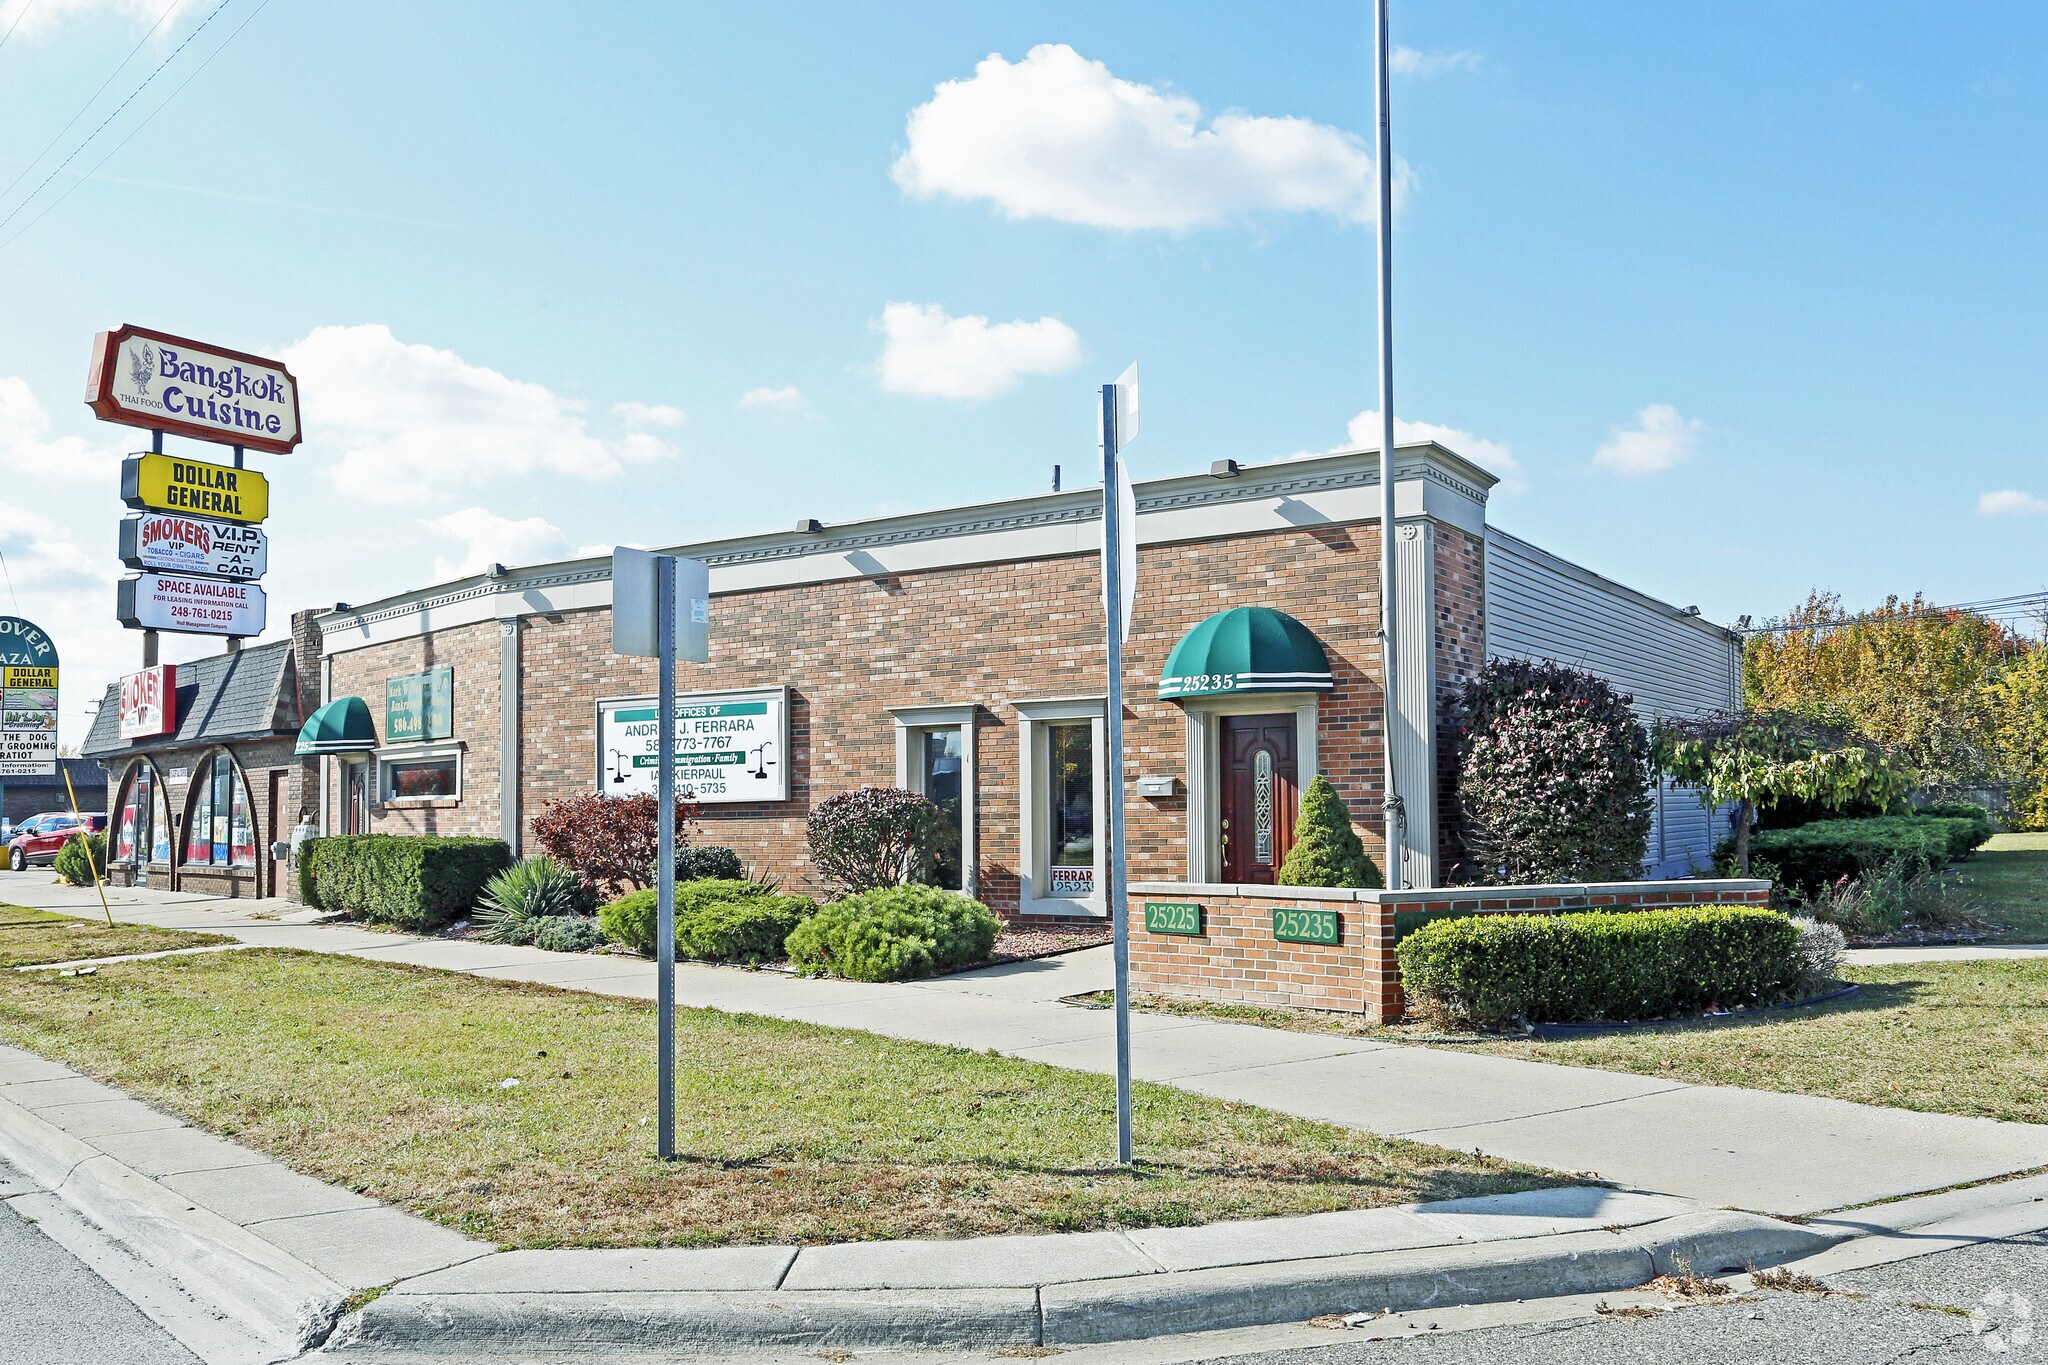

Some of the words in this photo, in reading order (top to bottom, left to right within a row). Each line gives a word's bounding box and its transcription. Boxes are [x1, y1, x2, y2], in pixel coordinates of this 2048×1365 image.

[158, 346, 286, 404] Bangkok
[120, 393, 139, 405] THAI
[140, 398, 164, 409] FOOD
[162, 386, 282, 434] Cuisine
[173, 462, 238, 492] DOLLAR
[167, 485, 242, 515] GENERAL
[212, 525, 261, 544] V.I.P.
[168, 541, 185, 550] VIP
[212, 541, 259, 555] RENT
[147, 547, 174, 556] TOBACCO
[179, 551, 205, 560] CIGARS
[216, 563, 254, 576] CAR
[157, 579, 192, 595] SPACE
[193, 583, 247, 600] AVAILABLE
[153, 594, 166, 602] FOR
[167, 596, 193, 604] LEASING
[193, 598, 234, 608] INFORMATION
[171, 606, 233, 621] 248-761-0215
[13, 668, 51, 677] DOLLAR
[10, 678, 53, 687] GENERAL
[1182, 673, 1234, 692] 25235
[675, 706, 707, 718] OFFICES
[709, 706, 721, 716] OF
[625, 723, 658, 737] ANDR
[680, 722, 690, 735] J.
[695, 718, 755, 733] FERRARA
[3, 733, 21, 741] THE
[29, 733, 48, 741] DOG
[645, 735, 732, 752] 58773-7767
[7, 742, 56, 750] GROOMING
[640, 756, 660, 766] Crimi
[674, 753, 712, 767] mmigration
[714, 752, 739, 765] Family
[674, 768, 726, 780] KIERPAUL
[1053, 870, 1093, 881] FERRAR
[1056, 881, 1094, 891] 2523
[1149, 905, 1195, 930] 25225
[1275, 911, 1334, 939] 25235
